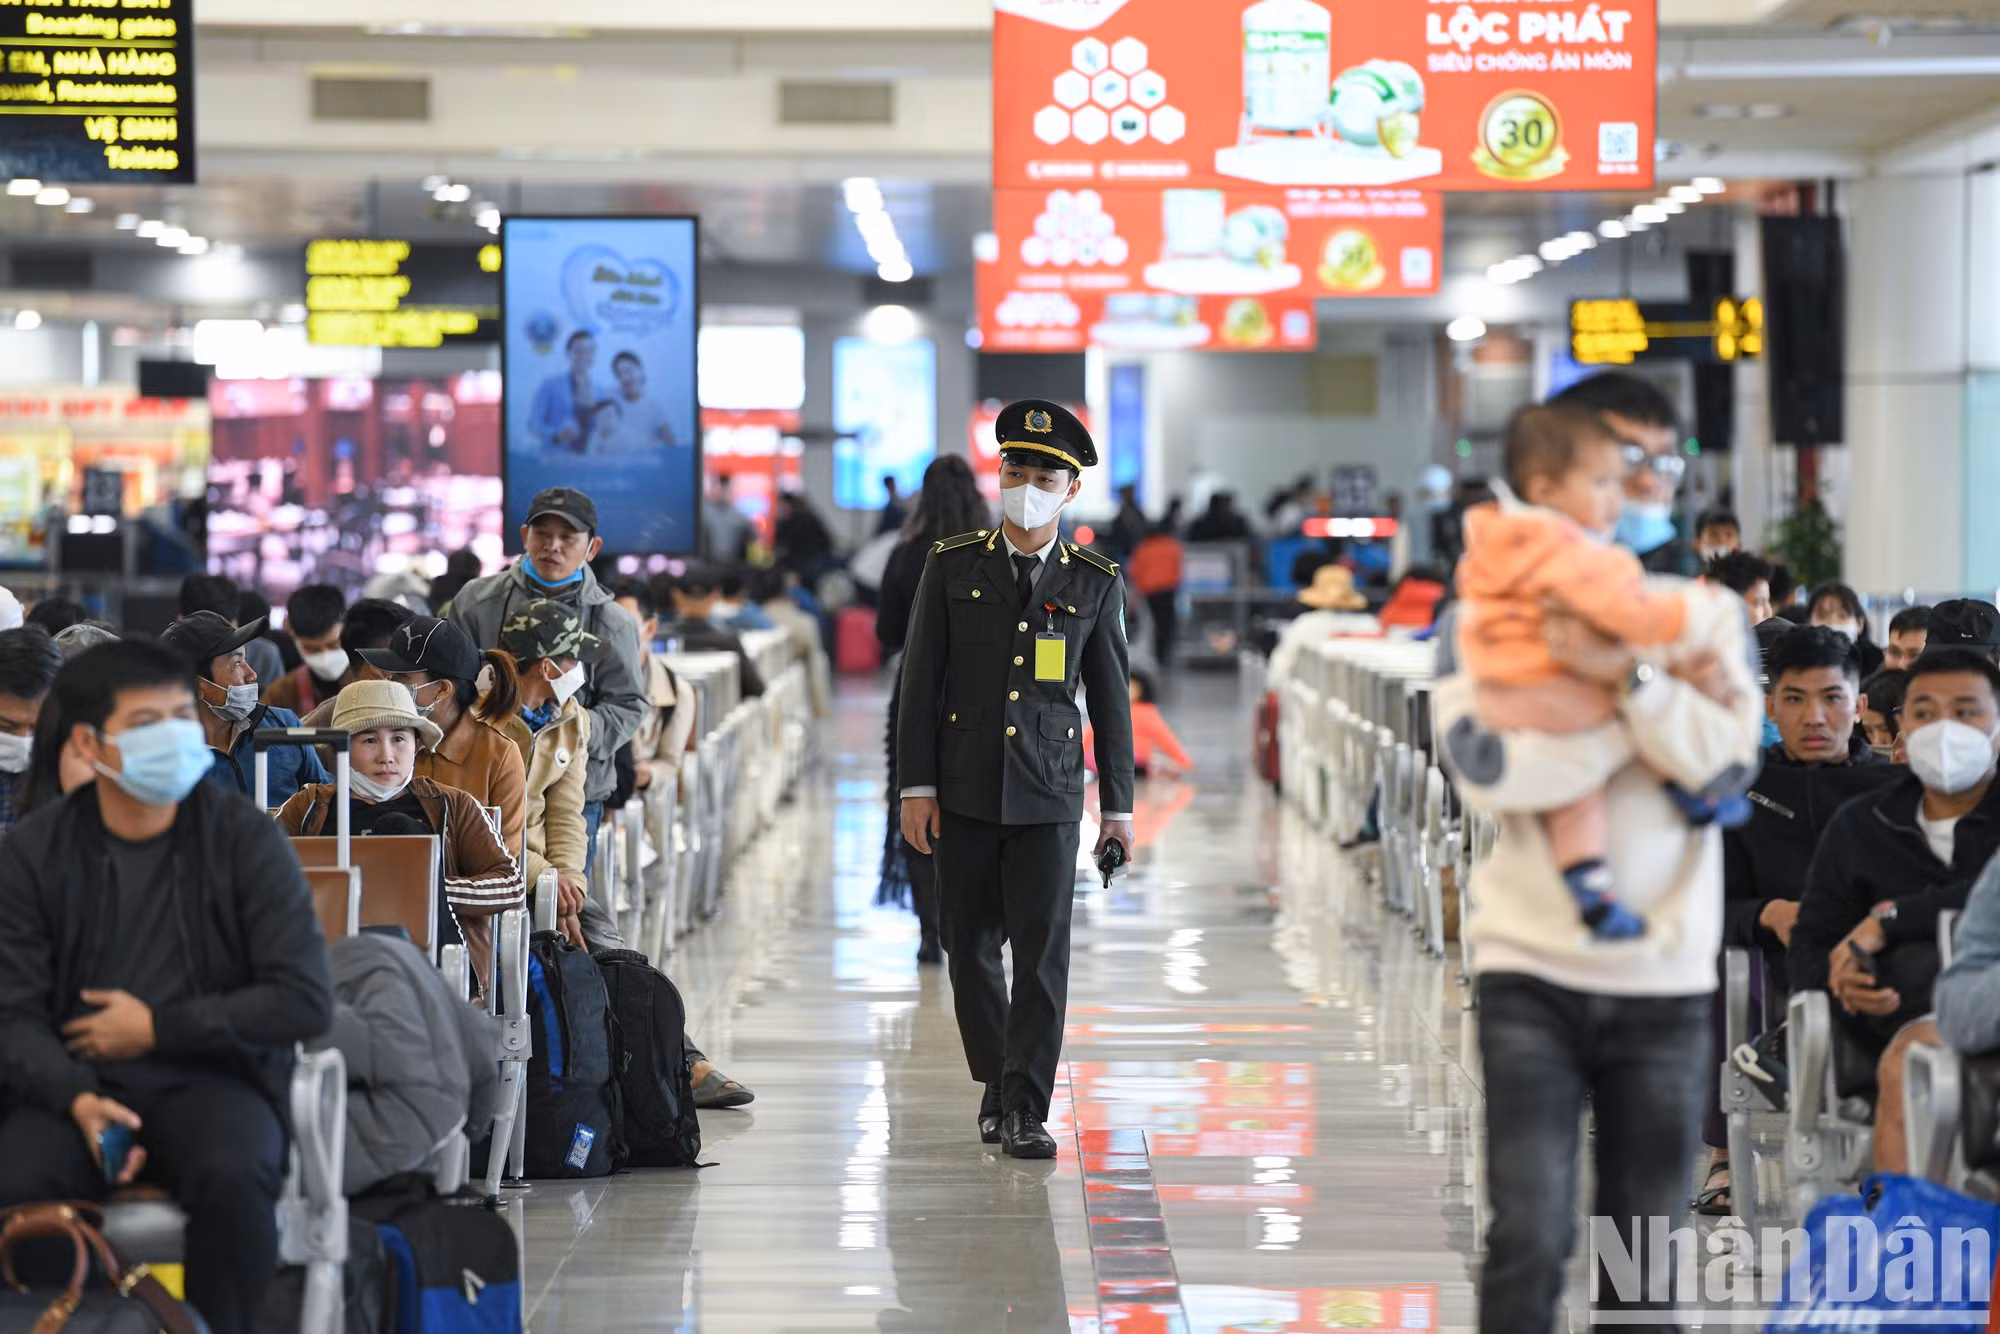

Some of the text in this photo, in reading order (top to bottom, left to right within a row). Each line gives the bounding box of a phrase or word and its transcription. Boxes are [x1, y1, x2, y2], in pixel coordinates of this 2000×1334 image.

[26, 12, 177, 40] Boarding gates
[1426, 2, 1632, 52] LỘC PHÁT
[53, 47, 106, 75] NHÀ
[107, 47, 177, 76] HÀNG
[1427, 49, 1473, 72] SIÊU
[56, 79, 177, 103] Restaurants
[84, 115, 178, 144] VỆ SINH
[1500, 119, 1543, 148] 30
[104, 145, 179, 170] Toilets
